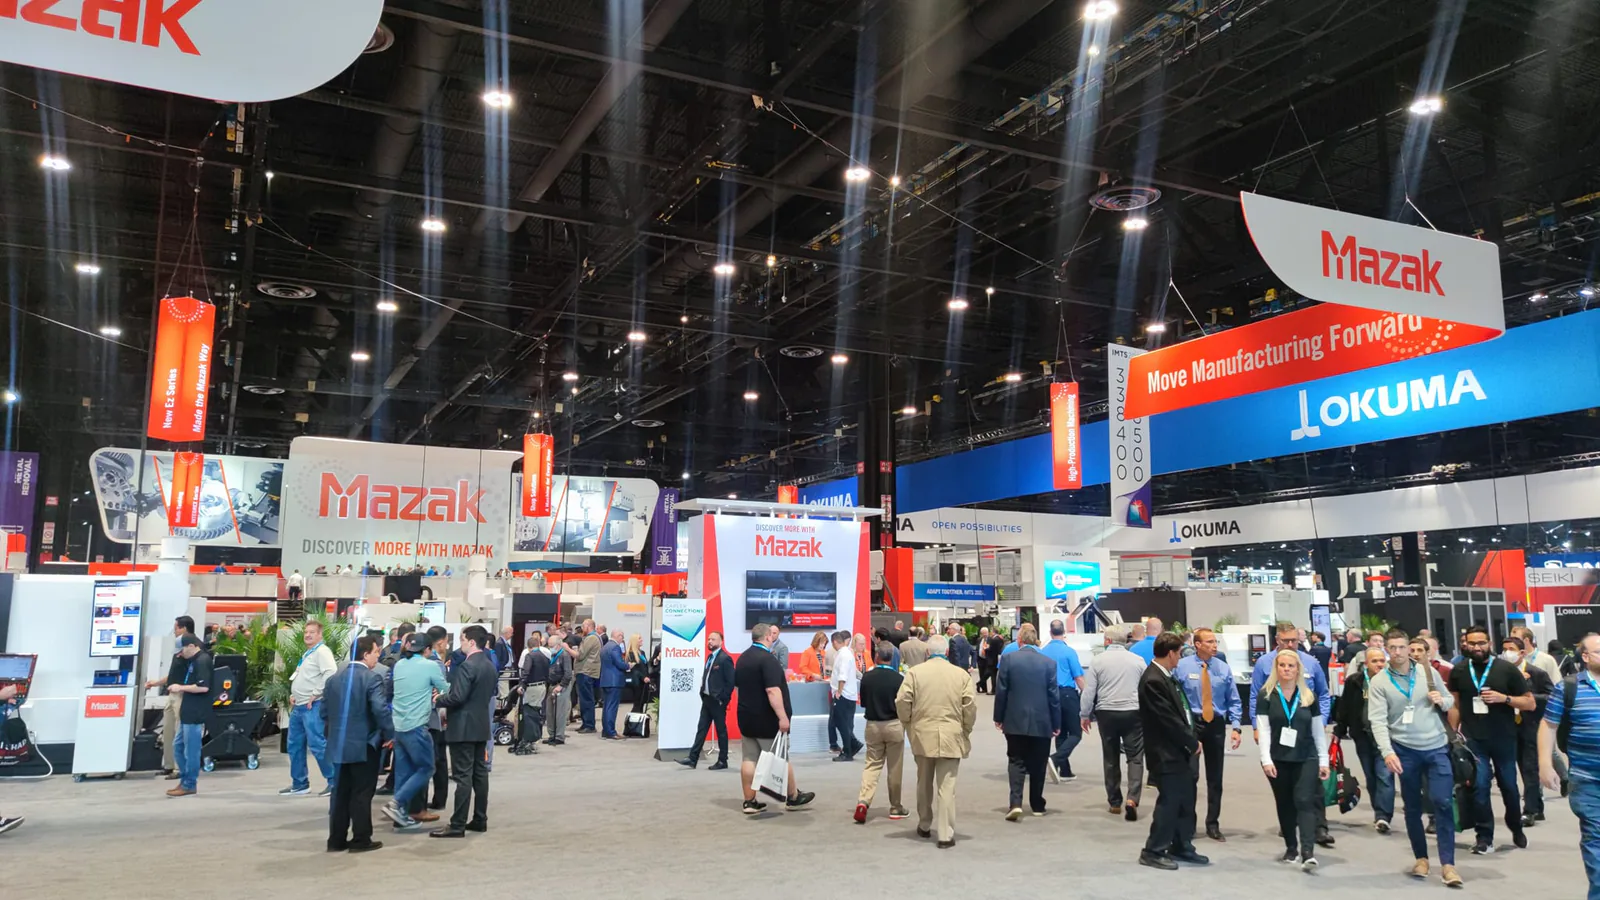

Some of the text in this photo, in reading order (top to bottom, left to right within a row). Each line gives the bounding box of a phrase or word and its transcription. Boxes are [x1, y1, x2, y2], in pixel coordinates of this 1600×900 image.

[1321, 230, 1445, 297] Mazak
[1112, 350, 1128, 358] IMTS
[1148, 370, 1187, 394] Move
[1192, 334, 1323, 384] Manufacturing
[166, 368, 177, 396] Series
[193, 343, 210, 433] Made the Mazak Way
[1319, 369, 1487, 427] OKUMA
[163, 410, 173, 428] New
[1066, 393, 1078, 481] High-Production Machining
[16, 458, 24, 483] METAL
[22, 458, 33, 496] REMOVAL
[319, 472, 487, 523] Mazak
[756, 524, 783, 532] DISCOVER
[932, 521, 1022, 532] OPEN POSSIBILITIES
[1181, 520, 1241, 538] OKUMA
[302, 539, 493, 558] DISCOVER MORE WITH MAZAK
[756, 534, 823, 558] Mazak
[1528, 572, 1574, 583] SEIKI
[665, 647, 700, 658] Mazak
[90, 702, 119, 711] Mazak
